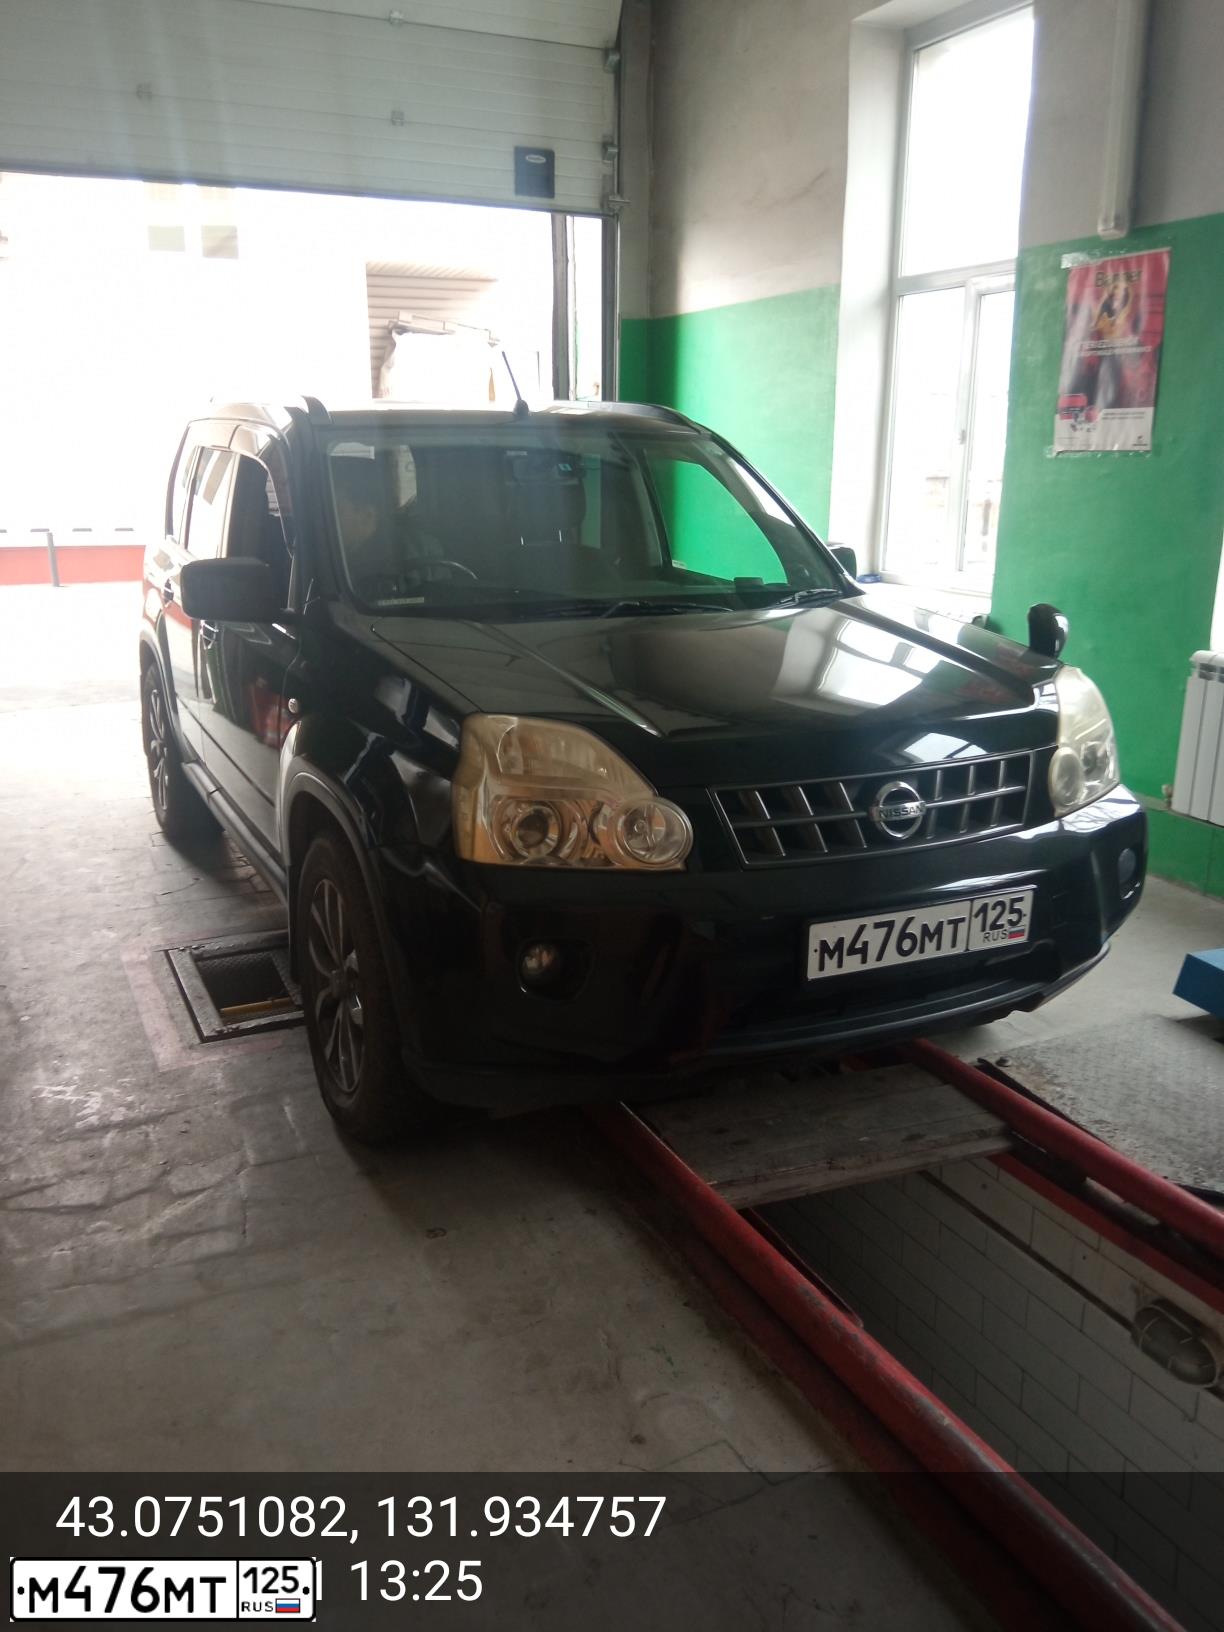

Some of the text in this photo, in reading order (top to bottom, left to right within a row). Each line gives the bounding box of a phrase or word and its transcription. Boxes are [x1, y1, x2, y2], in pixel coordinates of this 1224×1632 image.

[880, 805, 923, 819] NISSAN
[973, 896, 1026, 932] 125
[982, 929, 1008, 943] RUS
